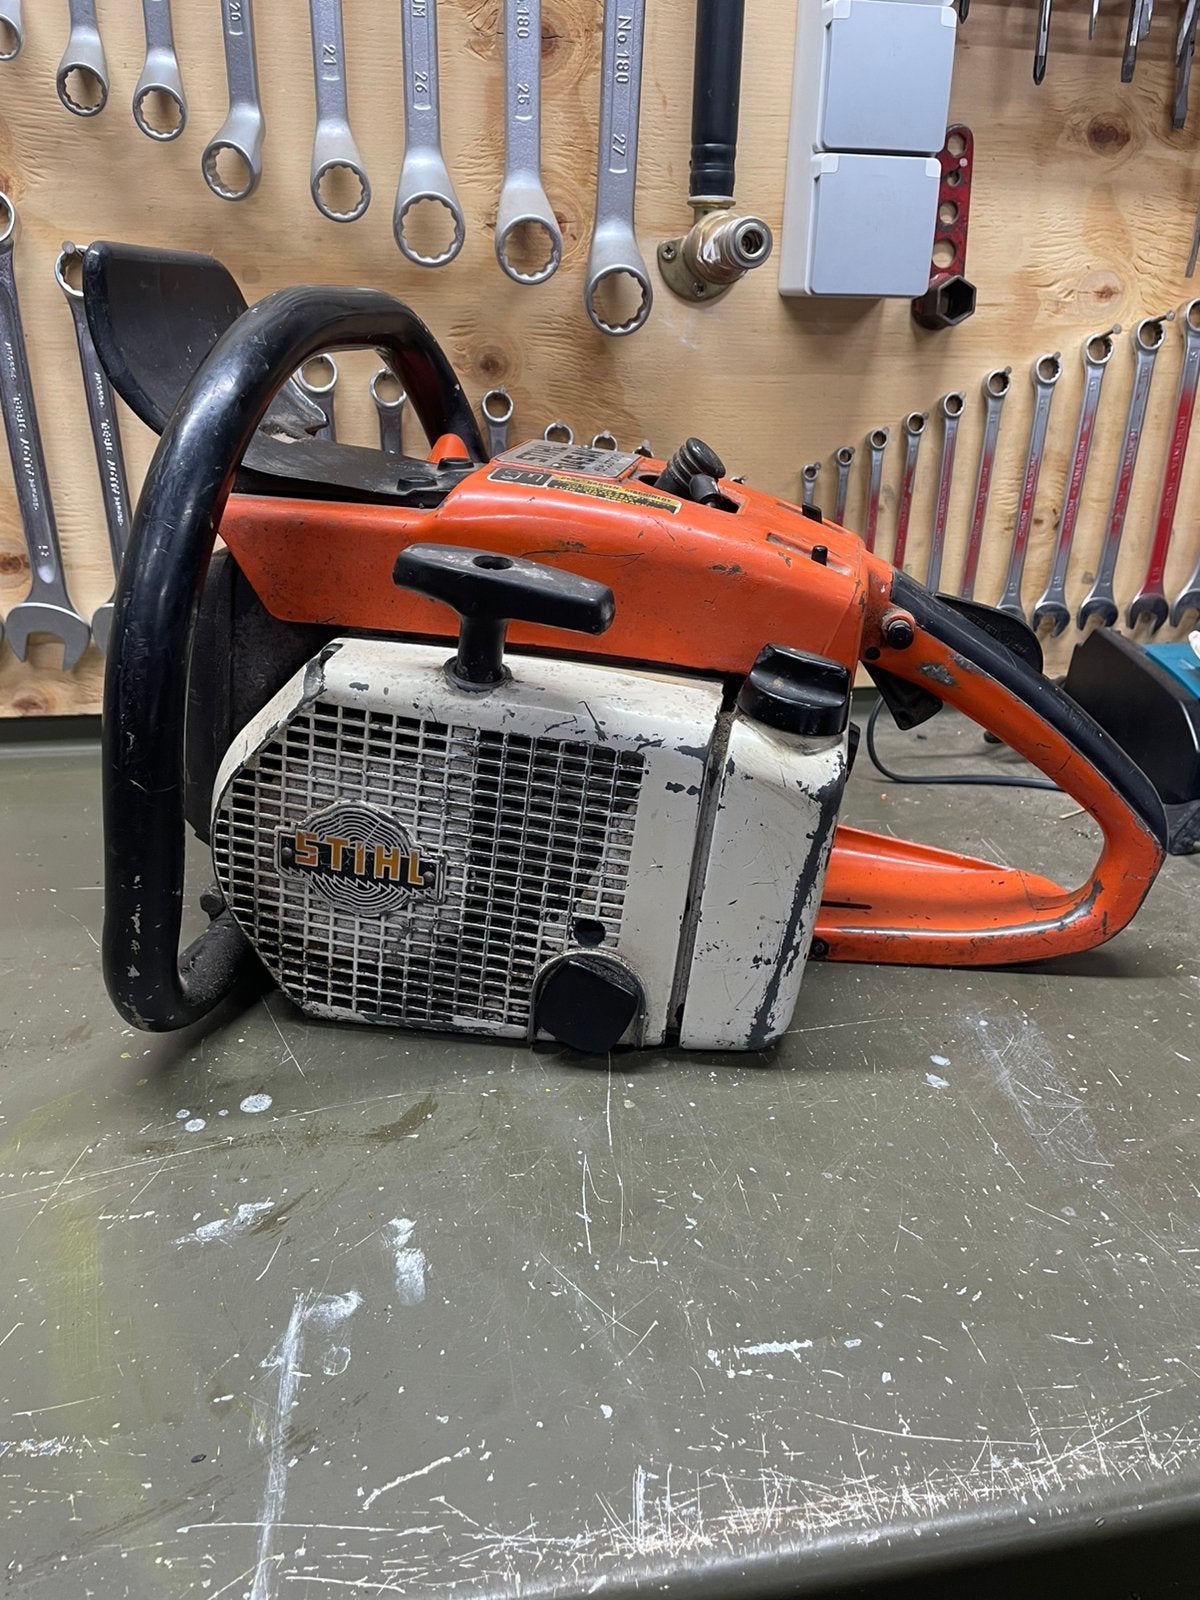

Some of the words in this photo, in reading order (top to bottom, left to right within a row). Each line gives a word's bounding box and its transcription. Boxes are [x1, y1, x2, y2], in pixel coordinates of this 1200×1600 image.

[322, 44, 337, 65] 21
[414, 71, 428, 93] 26
[612, 133, 627, 157] 27
[1072, 440, 1086, 488] VANADIUM
[295, 829, 425, 885] STIHL
